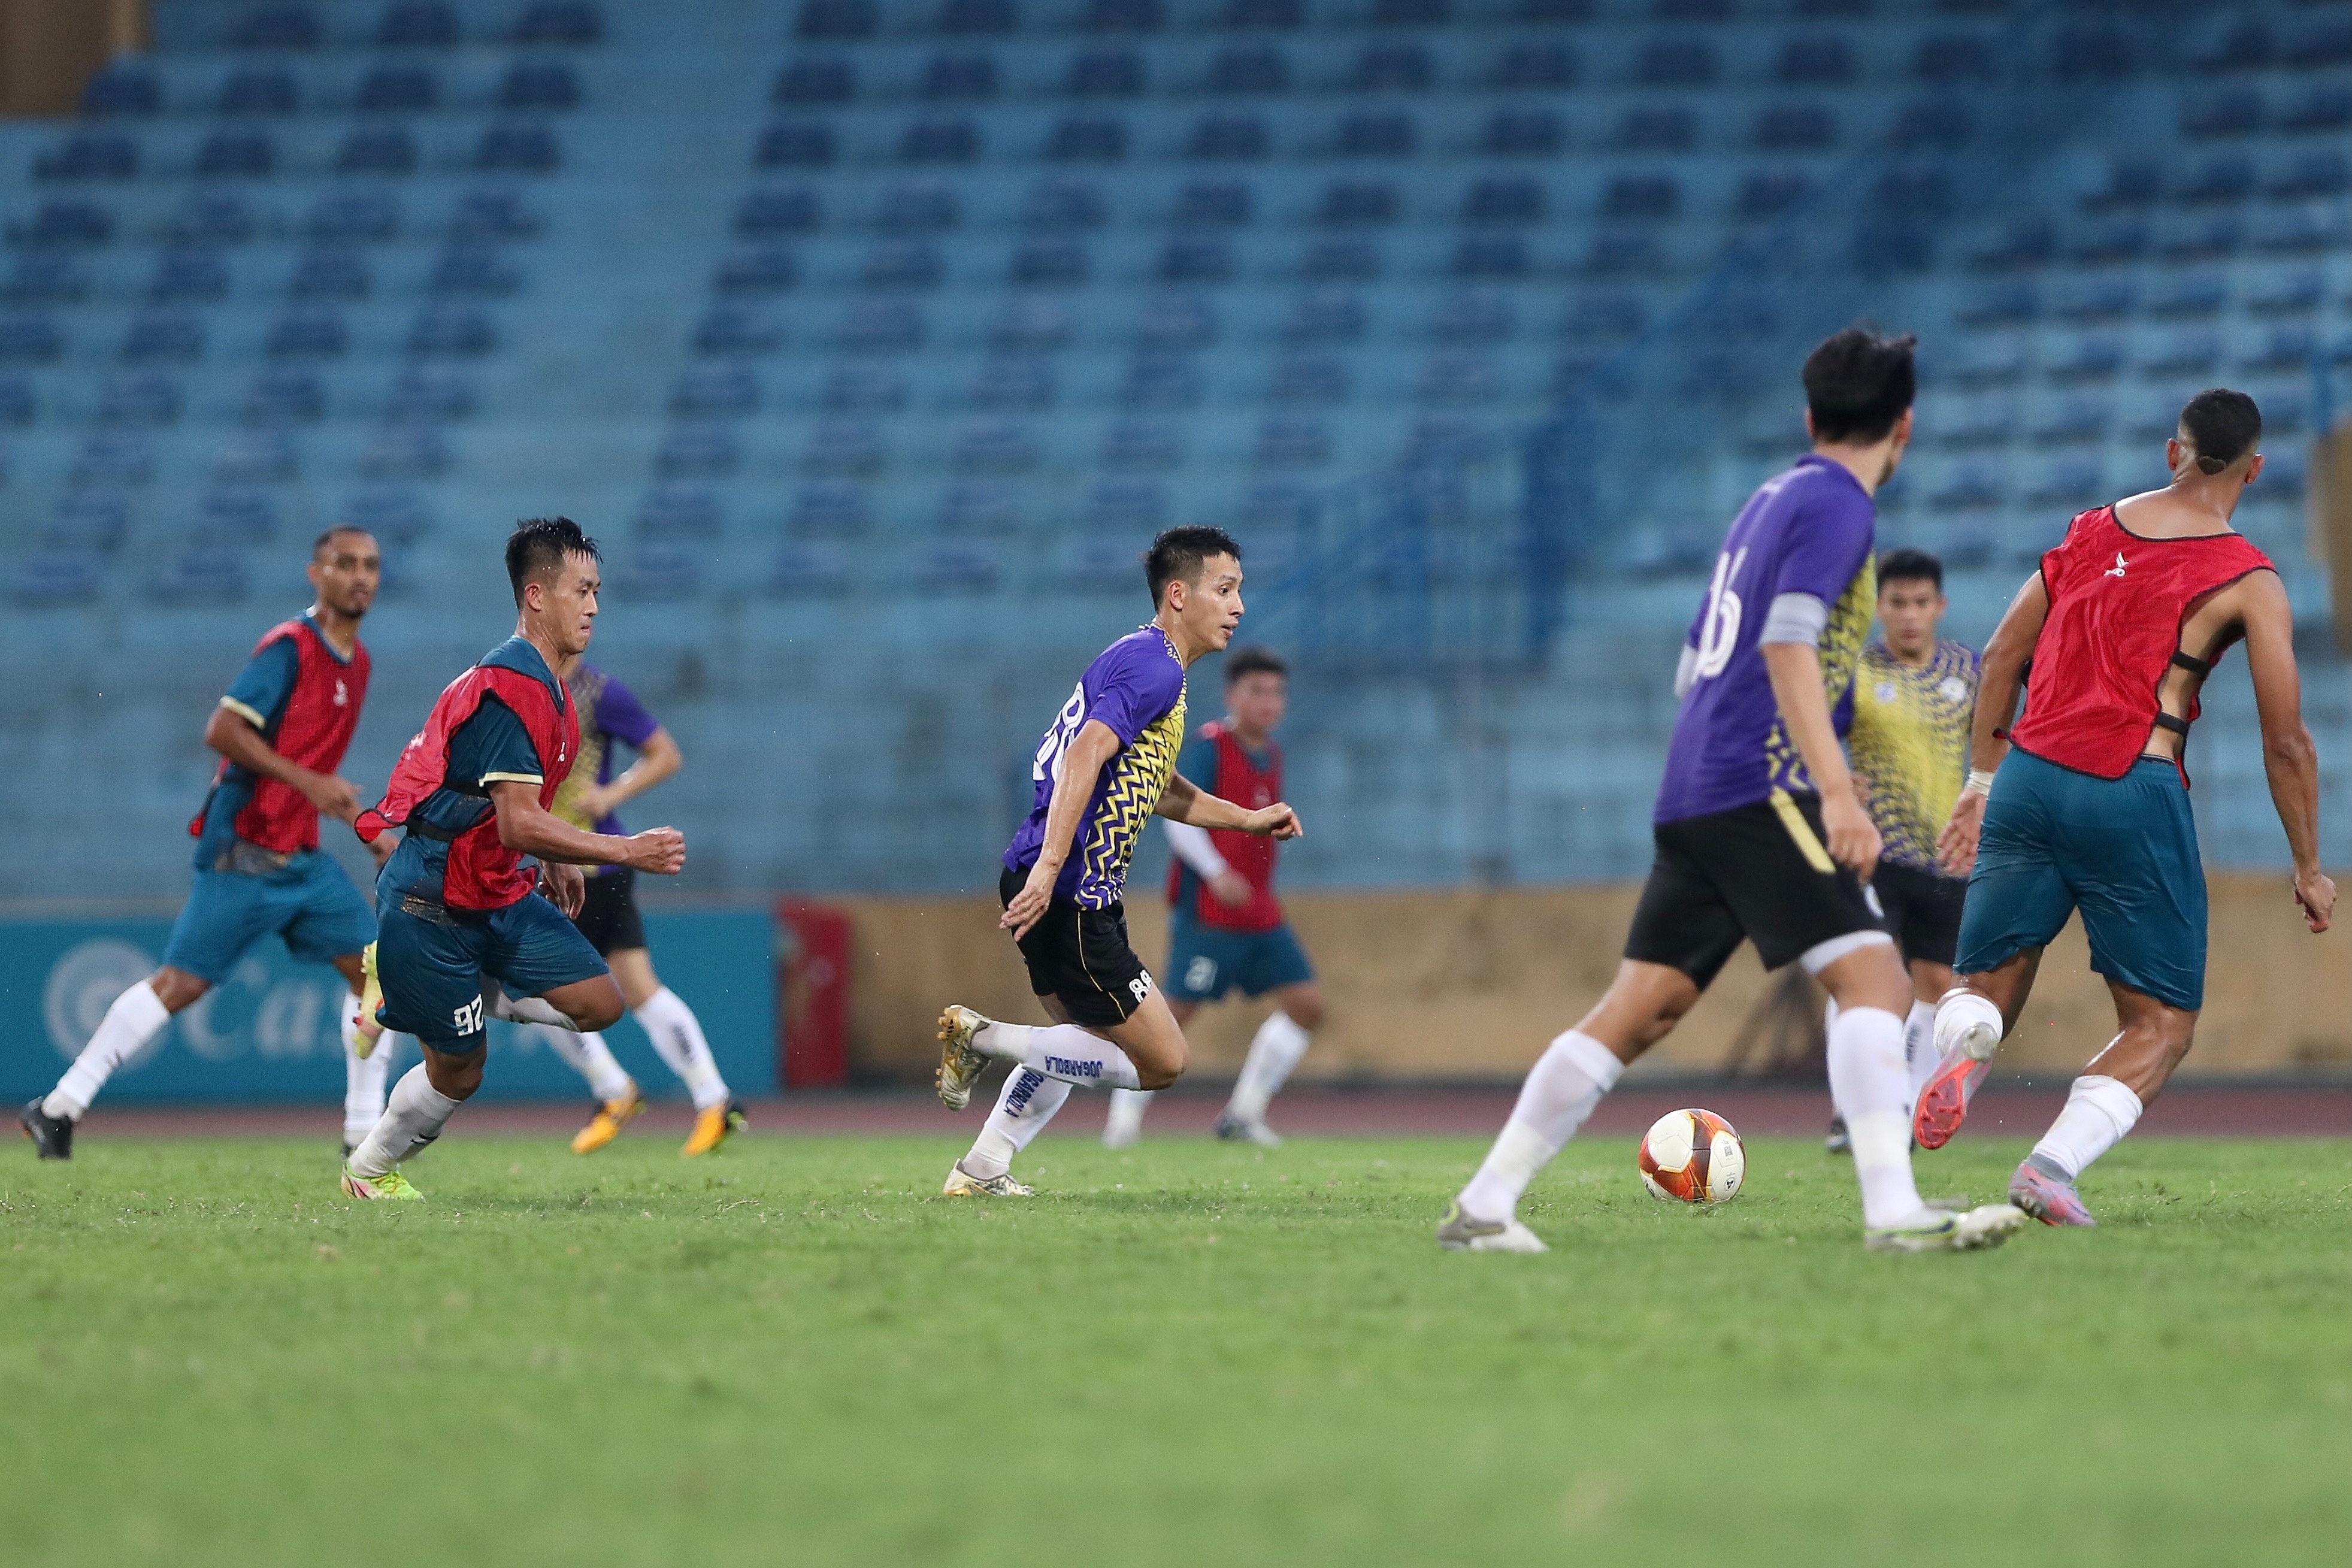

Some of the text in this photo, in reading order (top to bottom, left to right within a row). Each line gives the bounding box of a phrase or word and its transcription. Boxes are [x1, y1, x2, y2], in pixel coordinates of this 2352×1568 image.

[1128, 969, 1153, 1004] 88
[453, 993, 485, 1037] 92
[1045, 1055, 1103, 1078] JOGARBOLA
[1003, 1071, 1047, 1118] OGARBOLA
